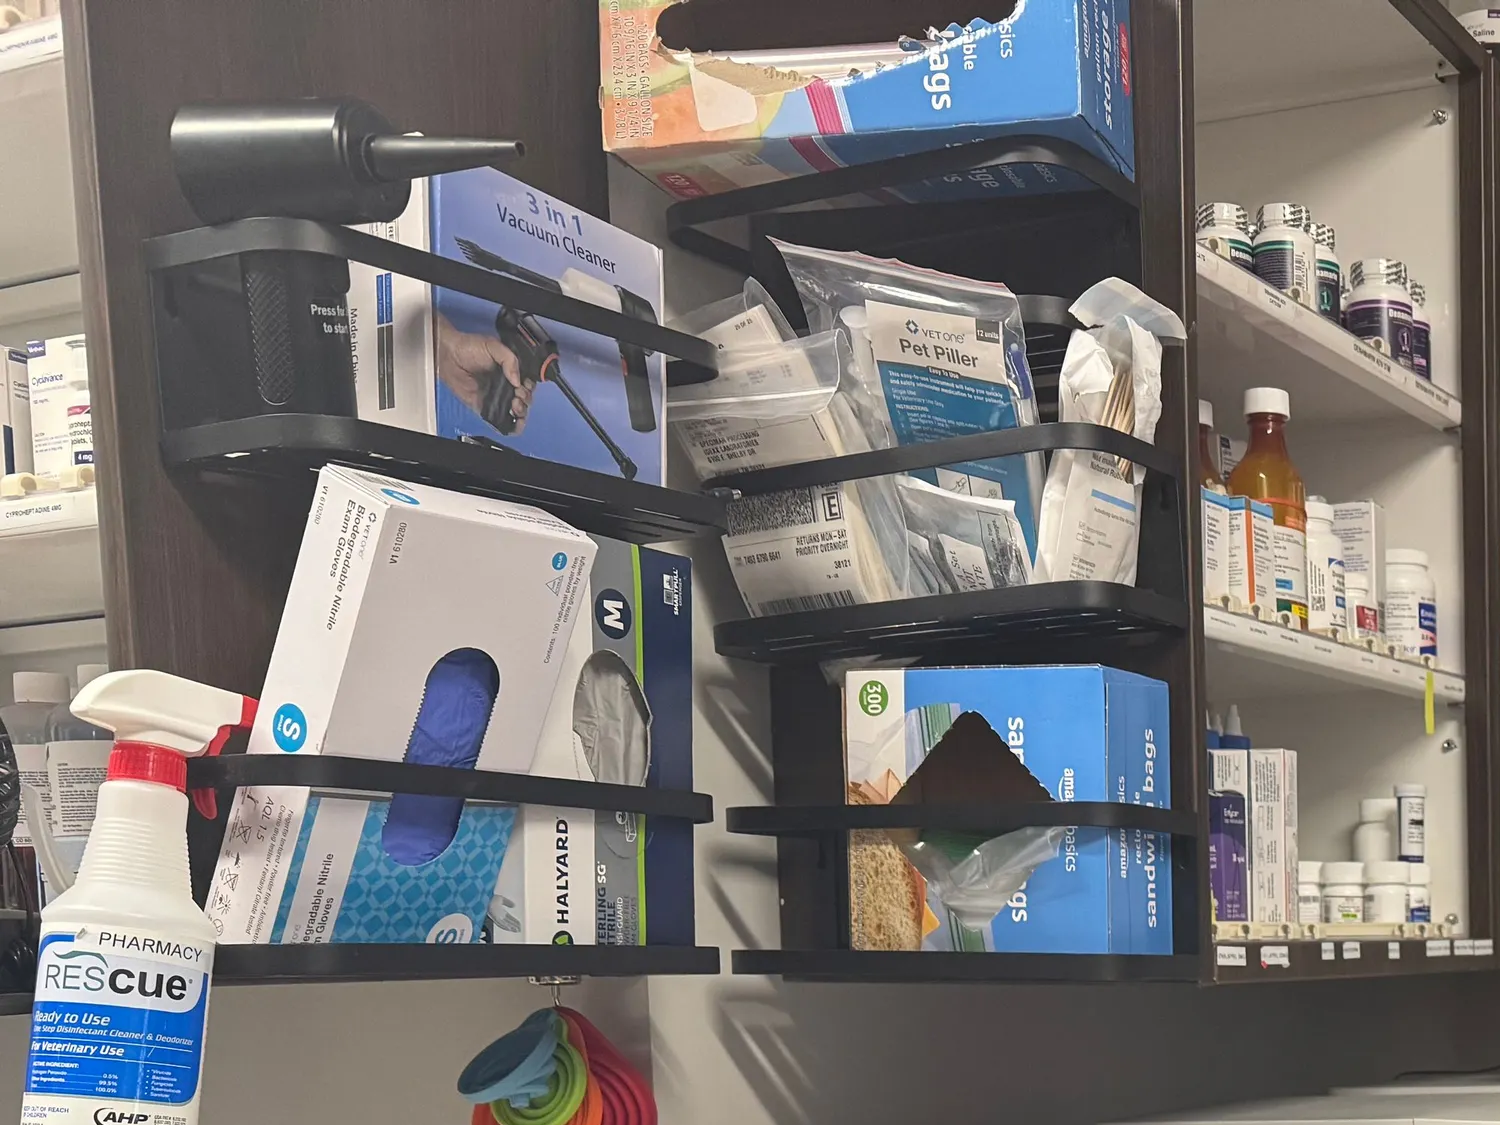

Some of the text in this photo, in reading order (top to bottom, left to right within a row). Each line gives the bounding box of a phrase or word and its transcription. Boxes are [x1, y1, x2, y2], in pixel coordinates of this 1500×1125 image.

[1472, 29, 1496, 38] Saline
[638, 44, 650, 68] BAGS
[640, 76, 651, 114] GALLON
[642, 116, 652, 137] SIZE
[526, 192, 583, 236] 3 in 1
[496, 204, 616, 274] Vacuum Cleaner
[310, 304, 336, 316] Press
[323, 322, 332, 334] to
[899, 338, 979, 368] Pet Piller
[32, 374, 64, 386] Cyclavance
[83, 453, 93, 462] mg
[1090, 460, 1109, 477] Natural
[828, 496, 838, 517] E
[329, 499, 356, 578] Exam Gloves
[390, 522, 408, 564] V1 610280
[796, 533, 820, 546] RETURNS
[796, 540, 849, 557] PRIORITY OVERNIGHT
[326, 504, 366, 631] Biodegradable Nitrile
[563, 555, 587, 622] nitrile gloves by weight
[556, 592, 568, 620] individual
[603, 599, 625, 630] M
[866, 683, 883, 714] 300
[283, 718, 300, 740] S
[1143, 728, 1156, 792] bags
[256, 796, 274, 848] AQL 1.5
[268, 867, 278, 890] Powder
[318, 853, 334, 890] Nitrile
[556, 818, 569, 924] HALYARD
[598, 864, 606, 884] SG
[317, 897, 334, 934] Gloves
[607, 902, 616, 945] ITRILE
[99, 932, 202, 962] PHARMACY
[34, 1010, 110, 1026] Ready to Use
[32, 1041, 124, 1056] For Veterinary Use
[56, 1026, 108, 1036] Disinfectant
[110, 1030, 144, 1040] Cleaner
[156, 1034, 194, 1046] Deodorizer
[103, 1111, 150, 1125] AHP
